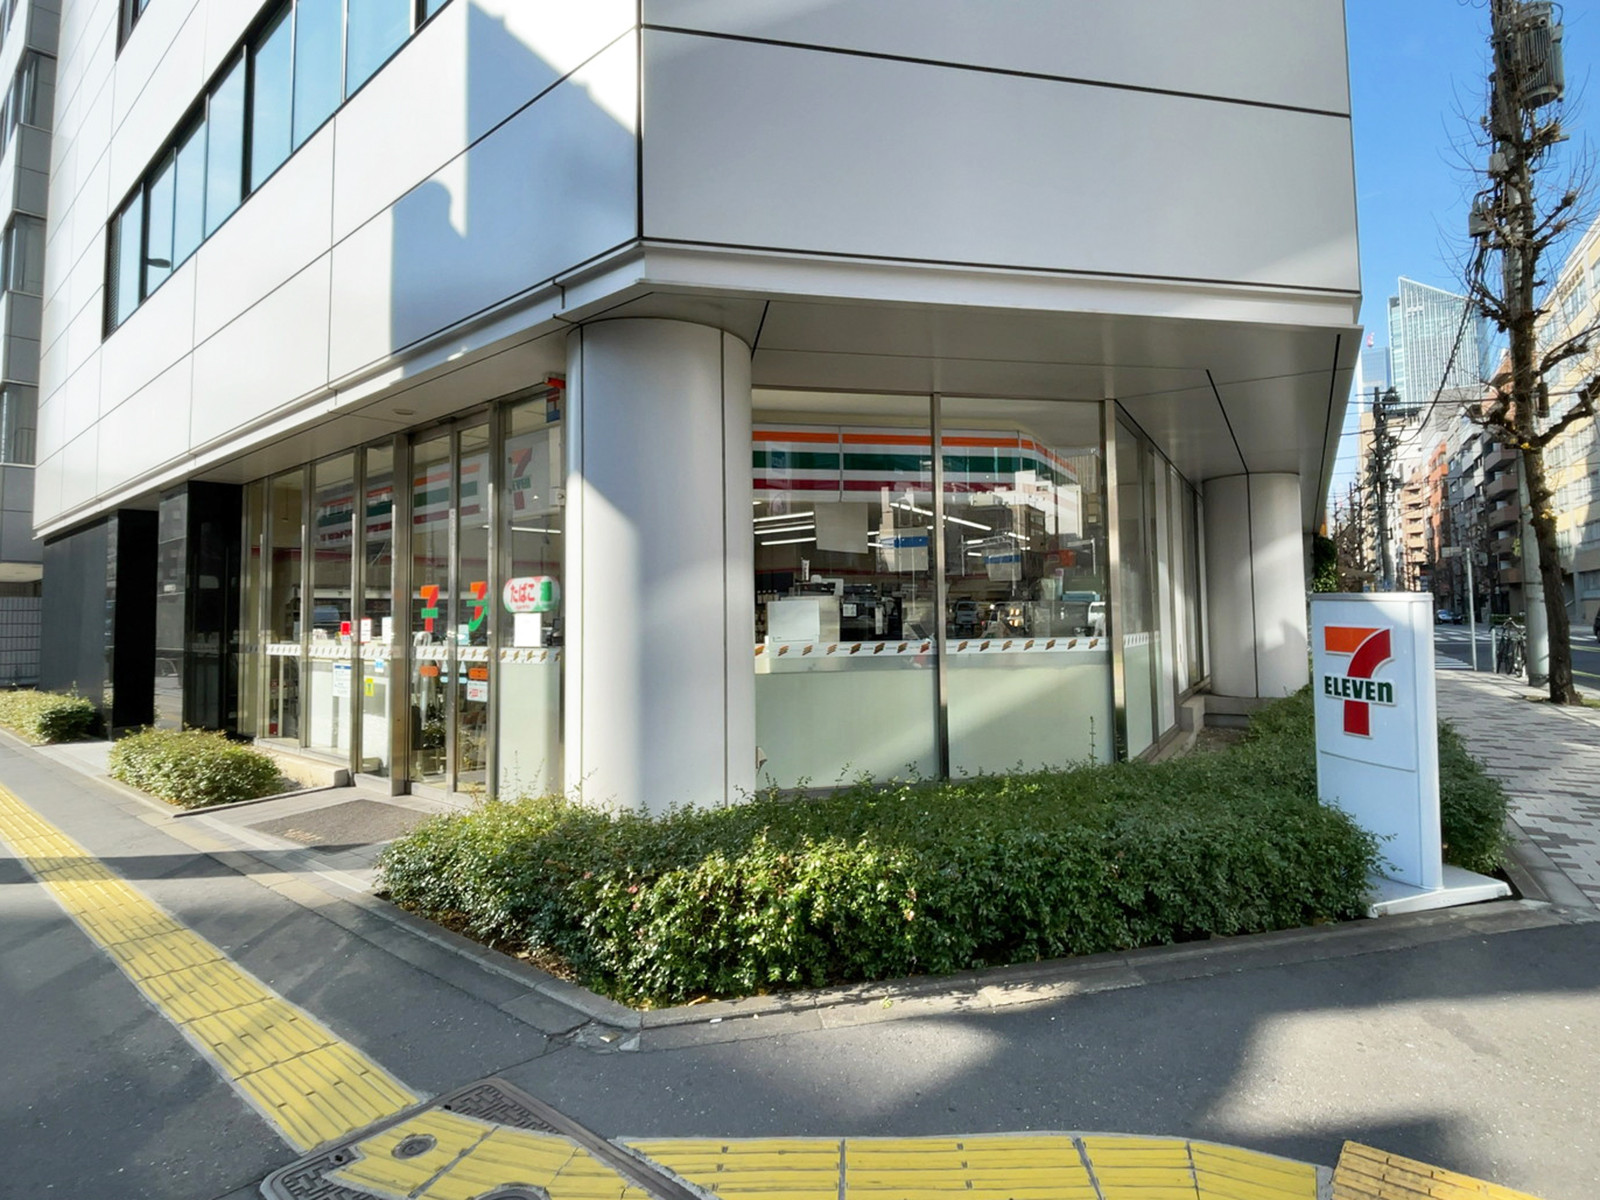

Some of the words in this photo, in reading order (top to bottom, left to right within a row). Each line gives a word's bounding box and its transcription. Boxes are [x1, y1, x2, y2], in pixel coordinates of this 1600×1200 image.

[511, 582, 535, 603] たばこ
[1324, 626, 1392, 736] 7
